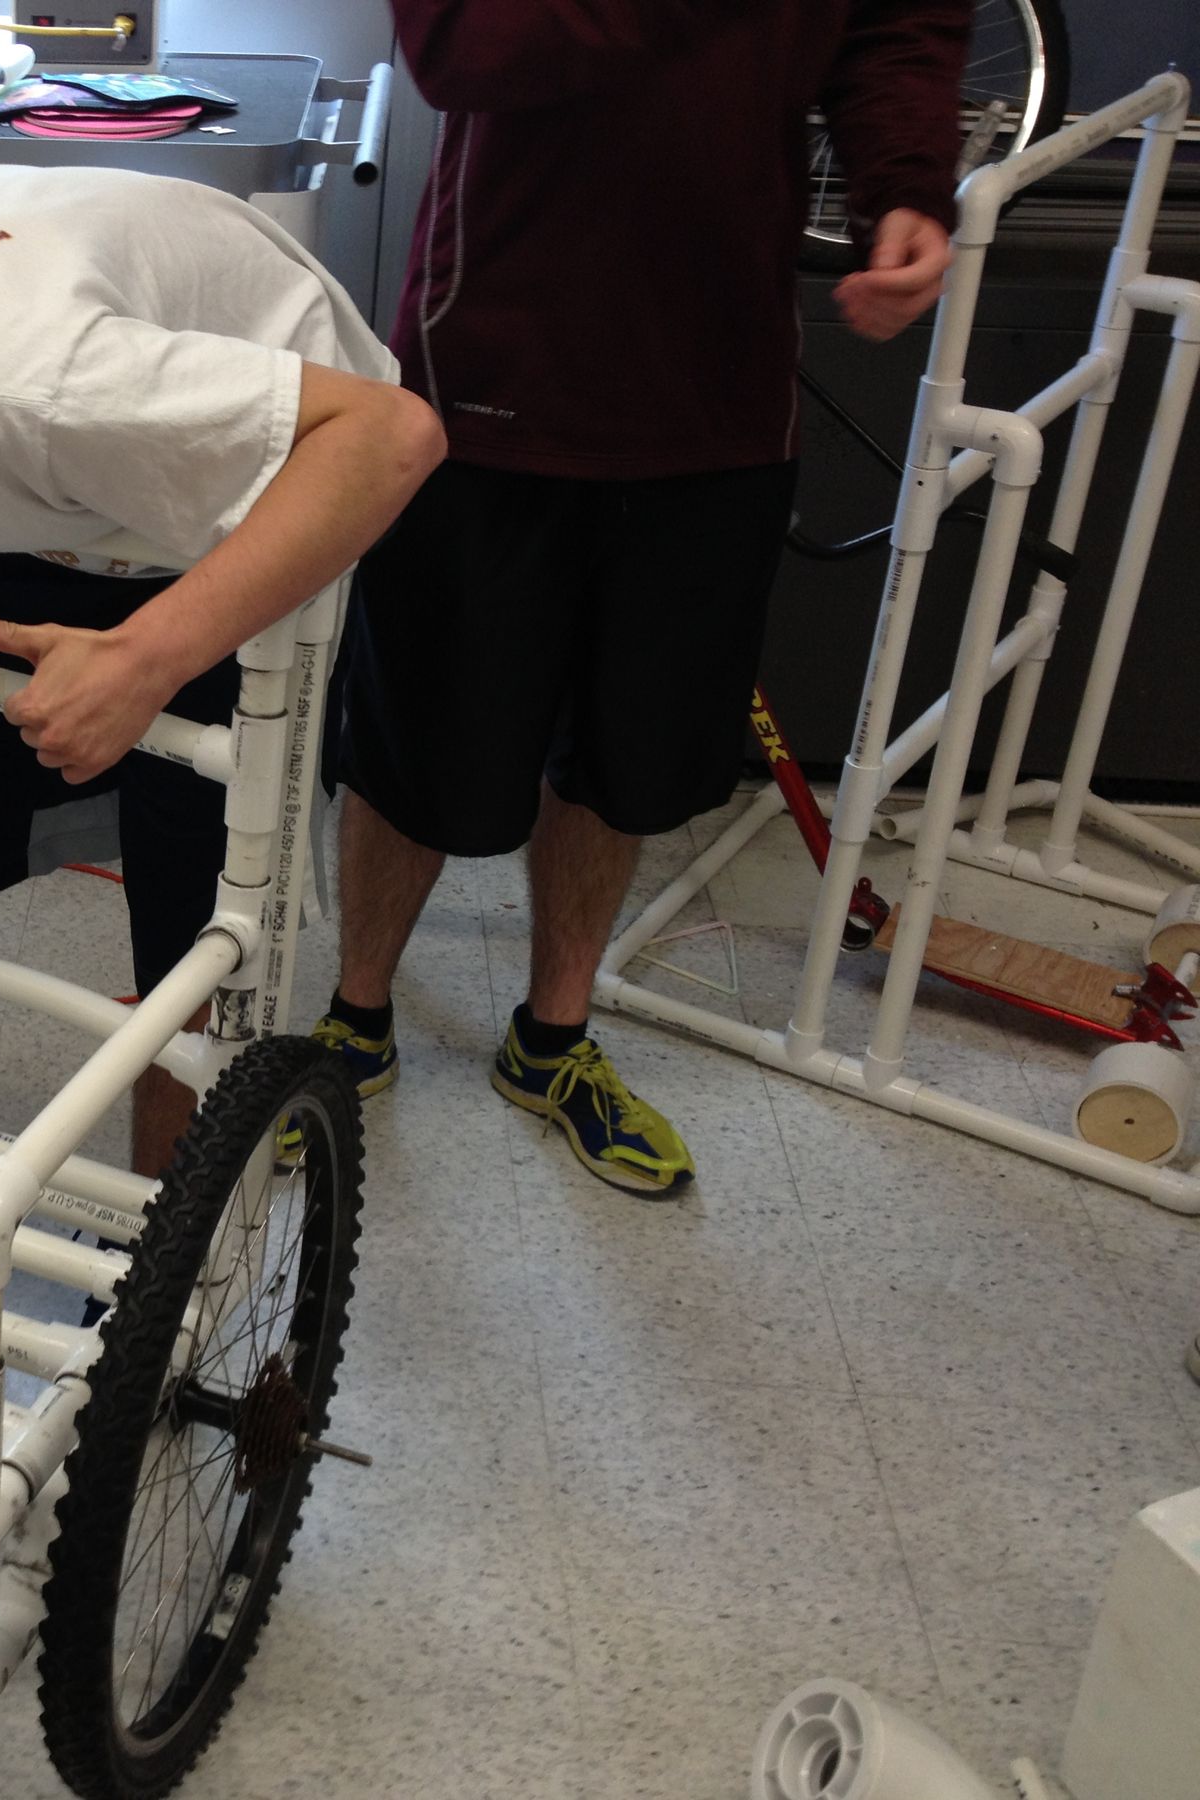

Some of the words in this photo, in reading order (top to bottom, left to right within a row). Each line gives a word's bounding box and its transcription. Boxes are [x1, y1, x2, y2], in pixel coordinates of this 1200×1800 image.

[297, 696, 312, 718] NSF
[292, 720, 309, 752] D1785
[289, 753, 306, 782] ASTM
[286, 783, 301, 801] 73F
[281, 833, 296, 852] 450
[276, 852, 293, 896] PVC1120
[273, 900, 288, 932] SCH40
[262, 995, 278, 1028] EAGLE
[95, 1210, 115, 1222] NSF
